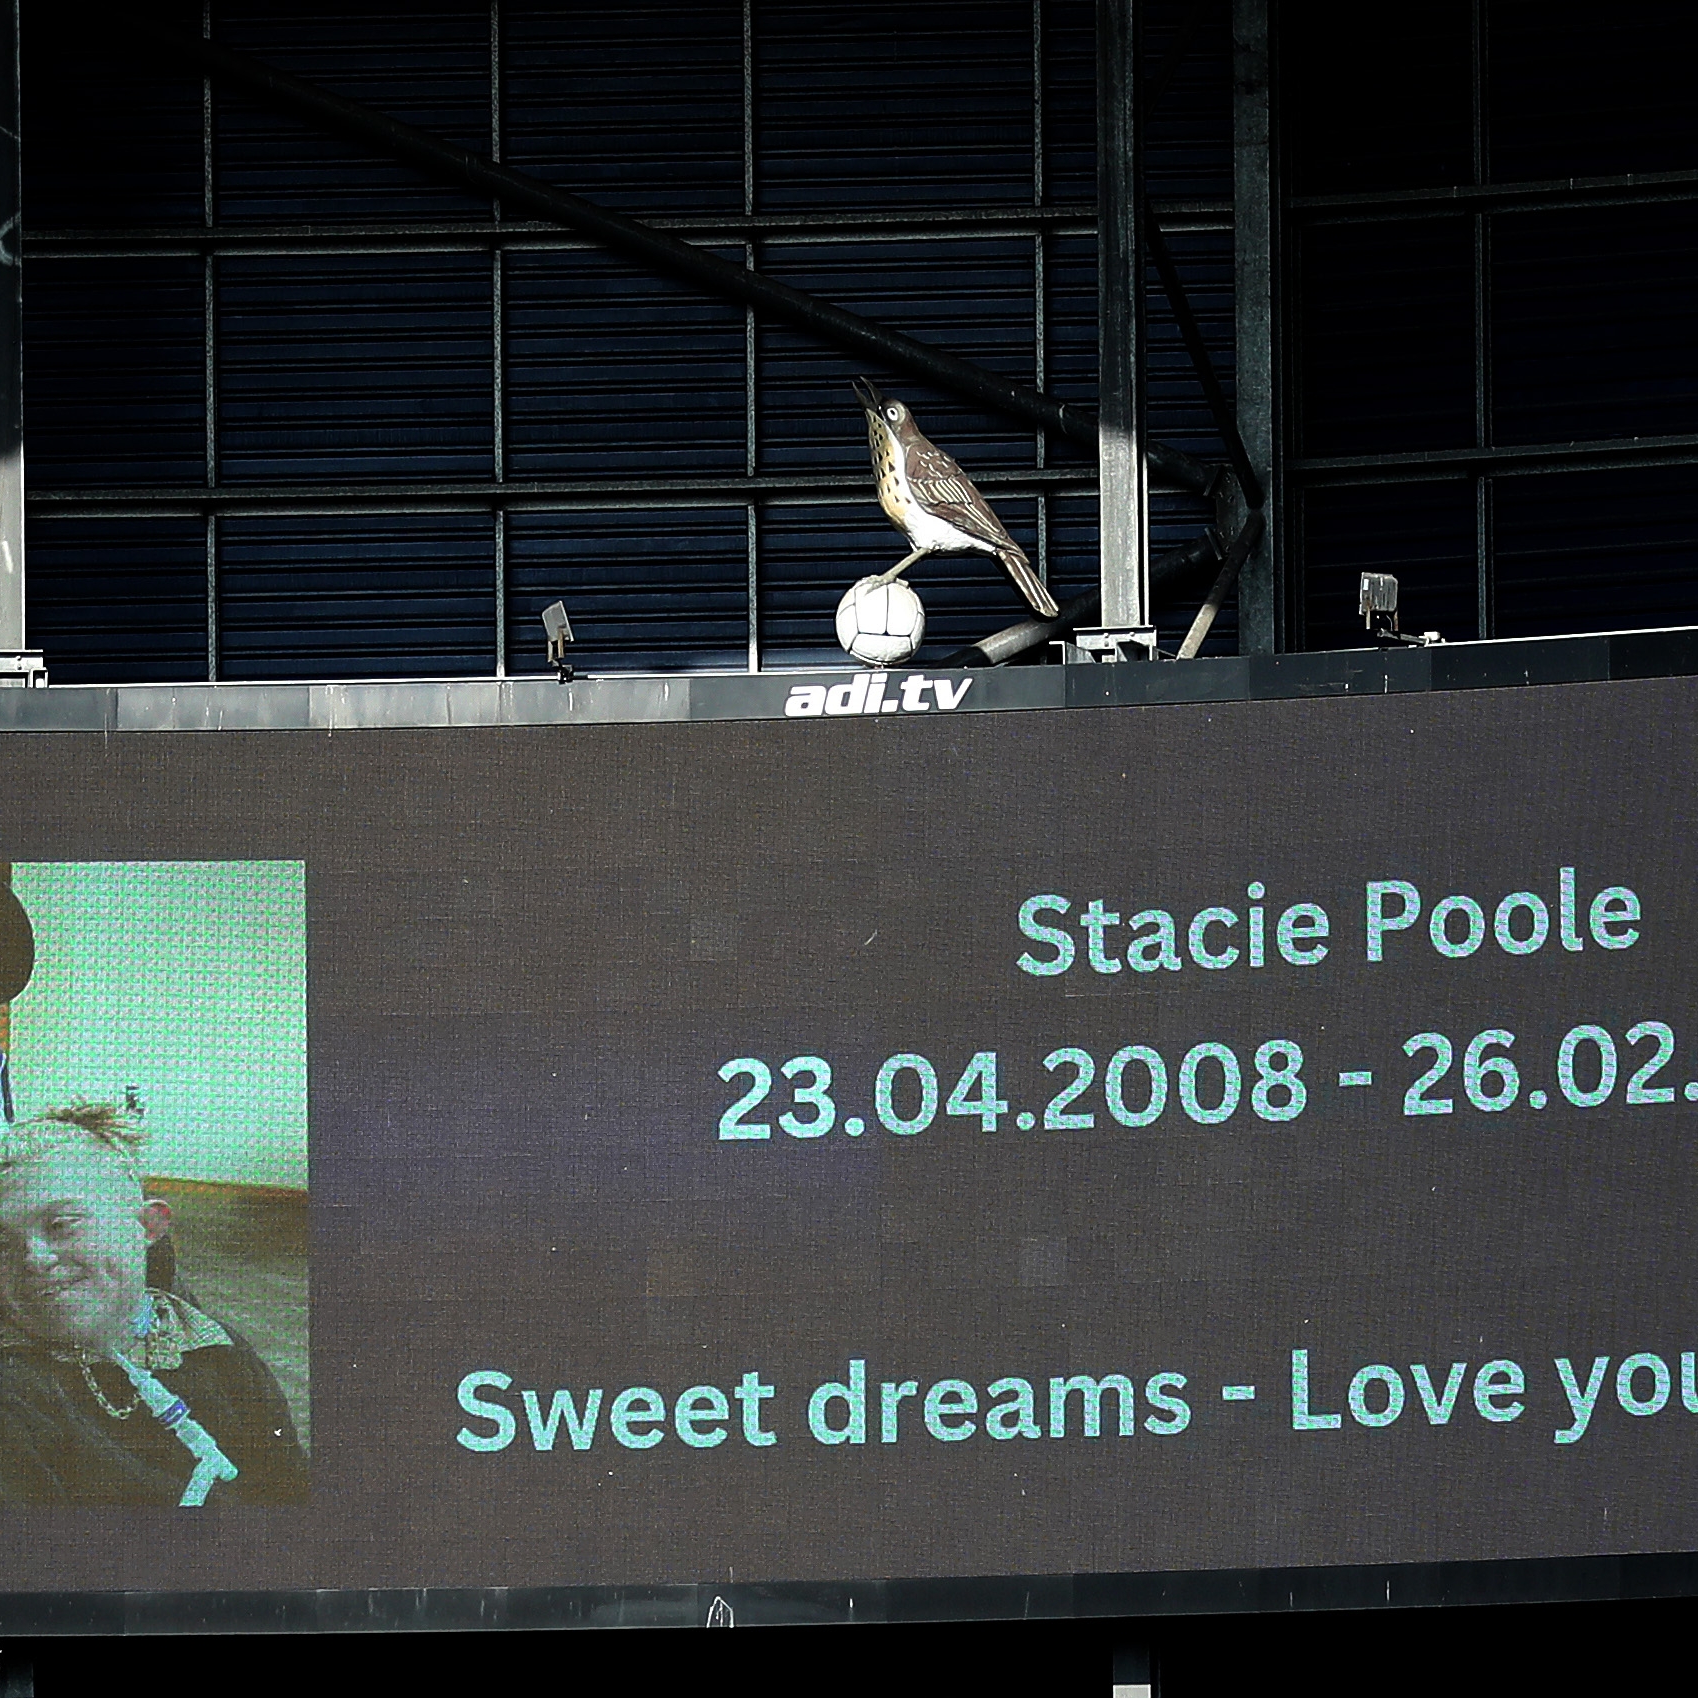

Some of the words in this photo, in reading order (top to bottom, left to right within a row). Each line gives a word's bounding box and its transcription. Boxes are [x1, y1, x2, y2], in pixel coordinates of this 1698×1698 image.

[784, 672, 973, 717] adi.tv
[1016, 881, 1329, 977] Stacie
[1366, 864, 1642, 963] Poole
[715, 1039, 1309, 1142] 23.04.2008
[455, 1367, 778, 1453] Sweet
[807, 1359, 1192, 1444] dreams
[1291, 1348, 1526, 1430] Love
